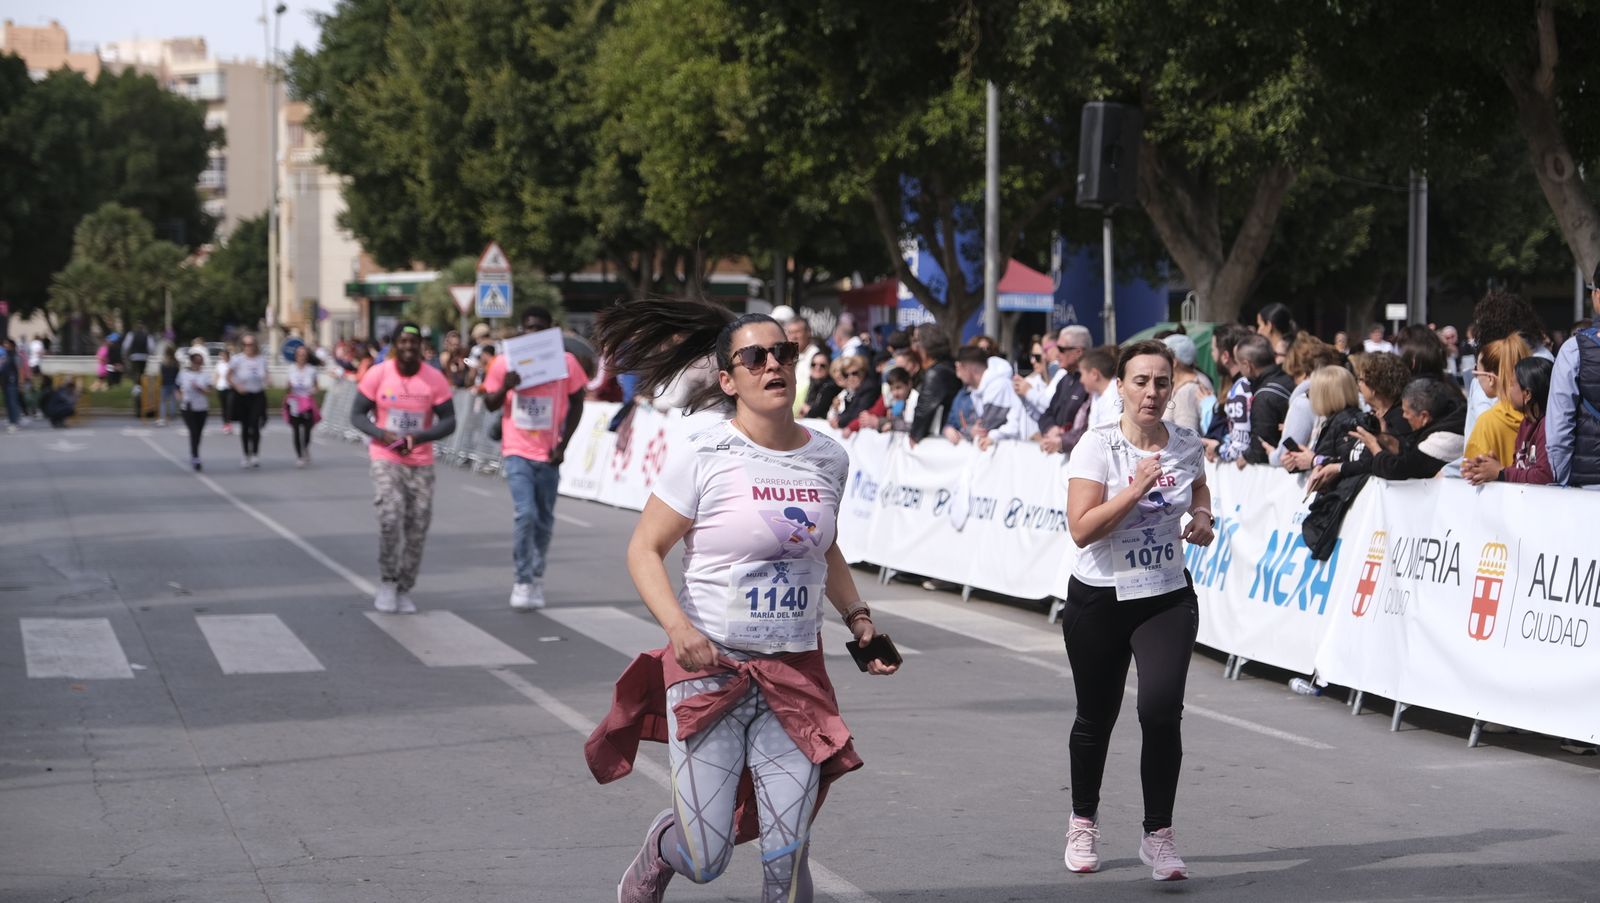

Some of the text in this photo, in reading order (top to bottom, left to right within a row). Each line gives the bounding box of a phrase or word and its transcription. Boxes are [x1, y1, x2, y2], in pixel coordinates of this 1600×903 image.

[752, 486, 820, 503] MUJER
[754, 477, 791, 486] CARRERA
[1125, 542, 1174, 568] 1076
[1391, 529, 1461, 586] ALMERÍA
[745, 585, 809, 611] 1140
[750, 610, 805, 619] MARÍA DEL MAR
[1521, 610, 1589, 648] CIUDAD
